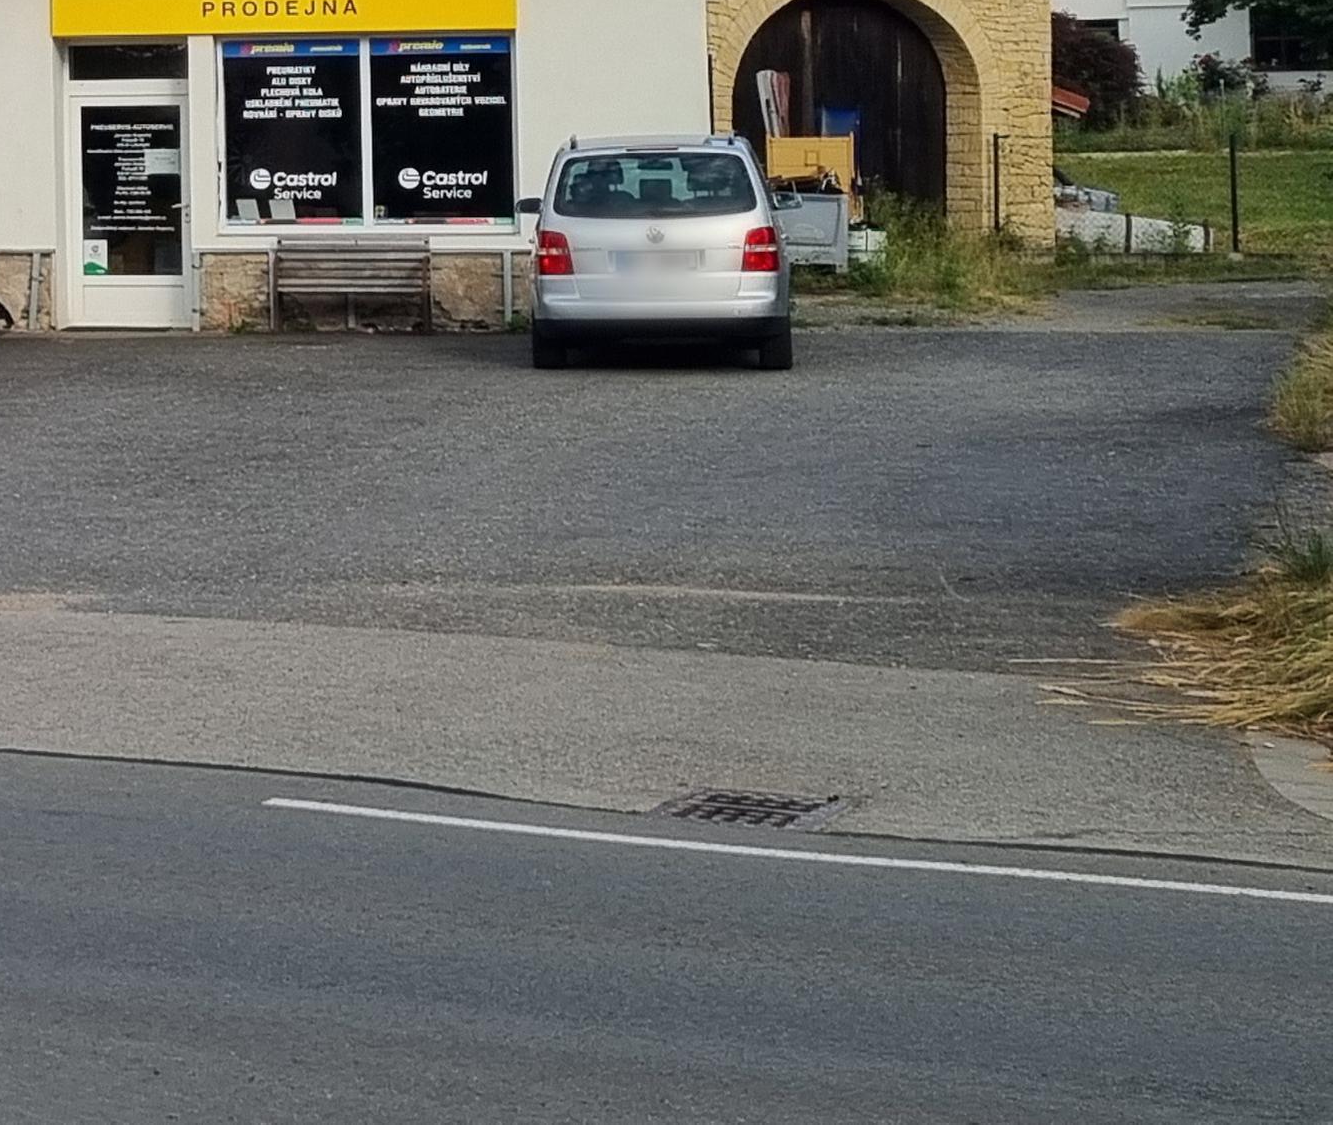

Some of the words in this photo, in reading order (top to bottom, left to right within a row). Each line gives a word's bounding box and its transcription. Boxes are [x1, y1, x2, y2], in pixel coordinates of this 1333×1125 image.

[202, 0, 358, 17] PRODEJNA
[266, 66, 316, 75] PNEUMATIKY
[288, 77, 313, 86] DISKY
[302, 87, 324, 96] KOLA
[273, 171, 337, 187] Castrol
[422, 170, 488, 186] Castrol
[273, 188, 322, 200] Service
[422, 187, 472, 199] Service
